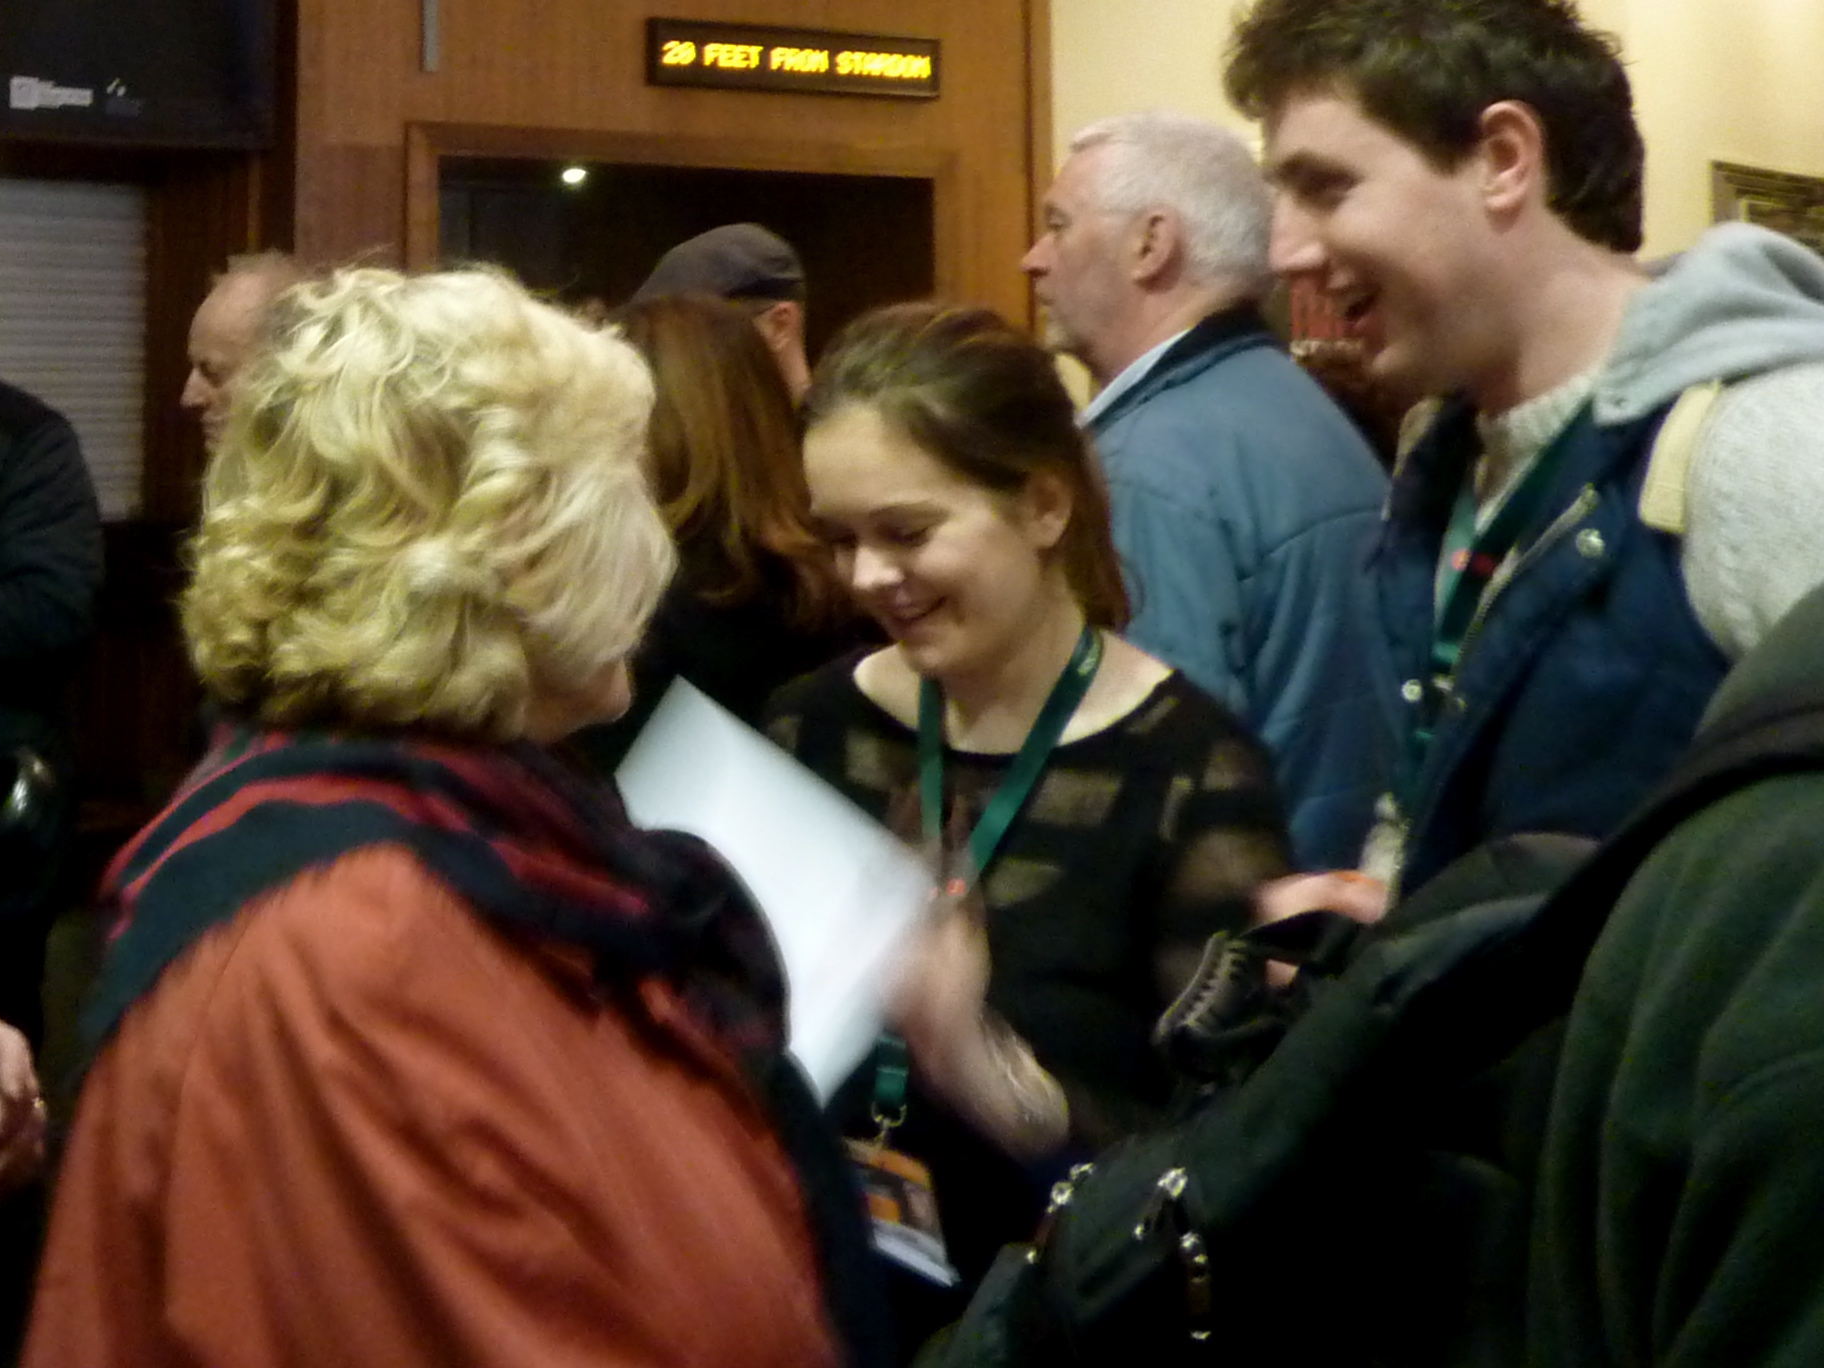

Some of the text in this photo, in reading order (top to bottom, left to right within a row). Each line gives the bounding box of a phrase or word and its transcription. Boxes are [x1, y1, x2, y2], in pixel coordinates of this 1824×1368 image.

[662, 40, 696, 66] 20
[703, 43, 763, 68] FEET
[770, 47, 829, 72] FROM
